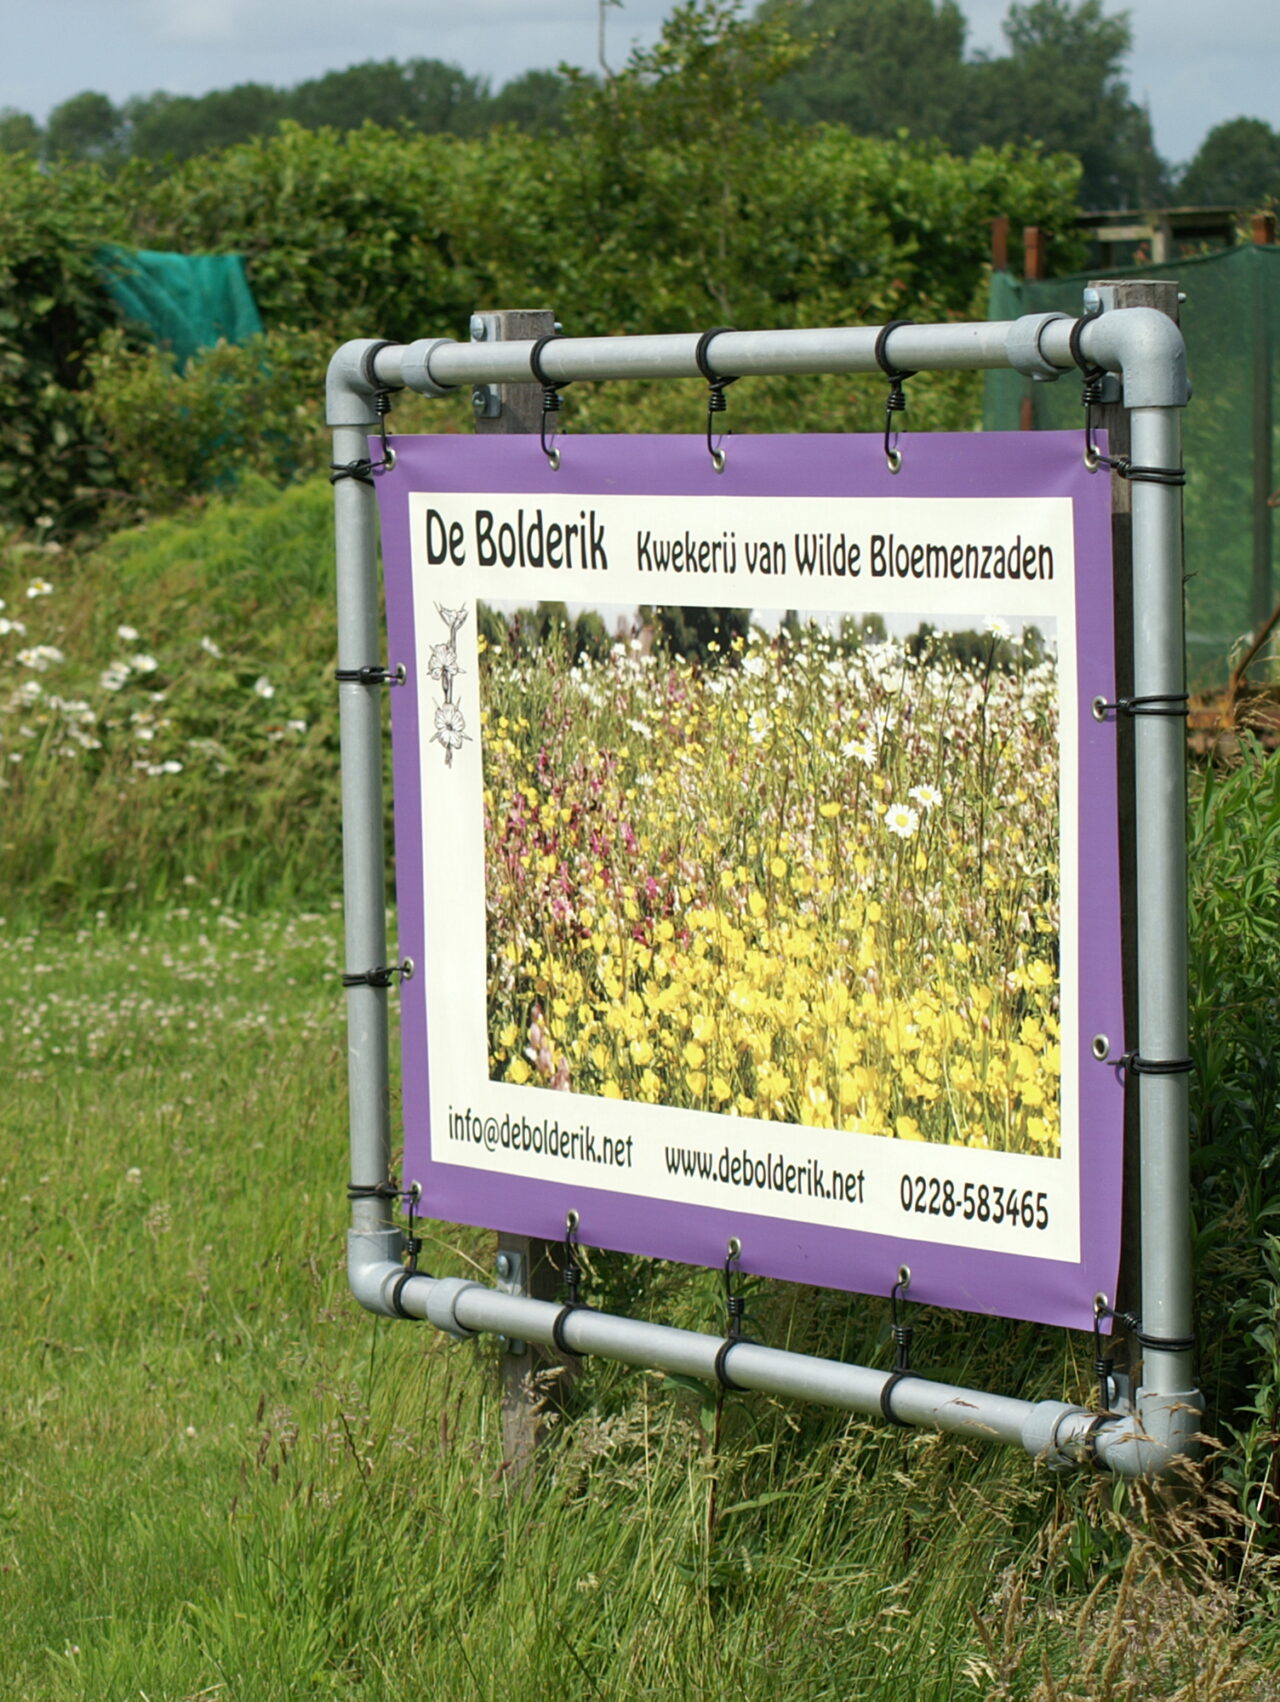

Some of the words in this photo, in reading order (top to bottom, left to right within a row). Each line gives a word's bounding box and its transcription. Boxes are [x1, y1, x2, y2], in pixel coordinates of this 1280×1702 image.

[426, 508, 466, 567] De
[475, 509, 608, 570] Bolderik
[637, 530, 737, 574] Kwekerij
[744, 541, 787, 575] van
[794, 533, 861, 578] Wilde
[870, 533, 1054, 581] Bloemenzaden
[448, 1105, 633, 1168] info@debolderik.net
[665, 1146, 865, 1204] www.debolderik.net
[900, 1174, 1049, 1230] 0228-583465
